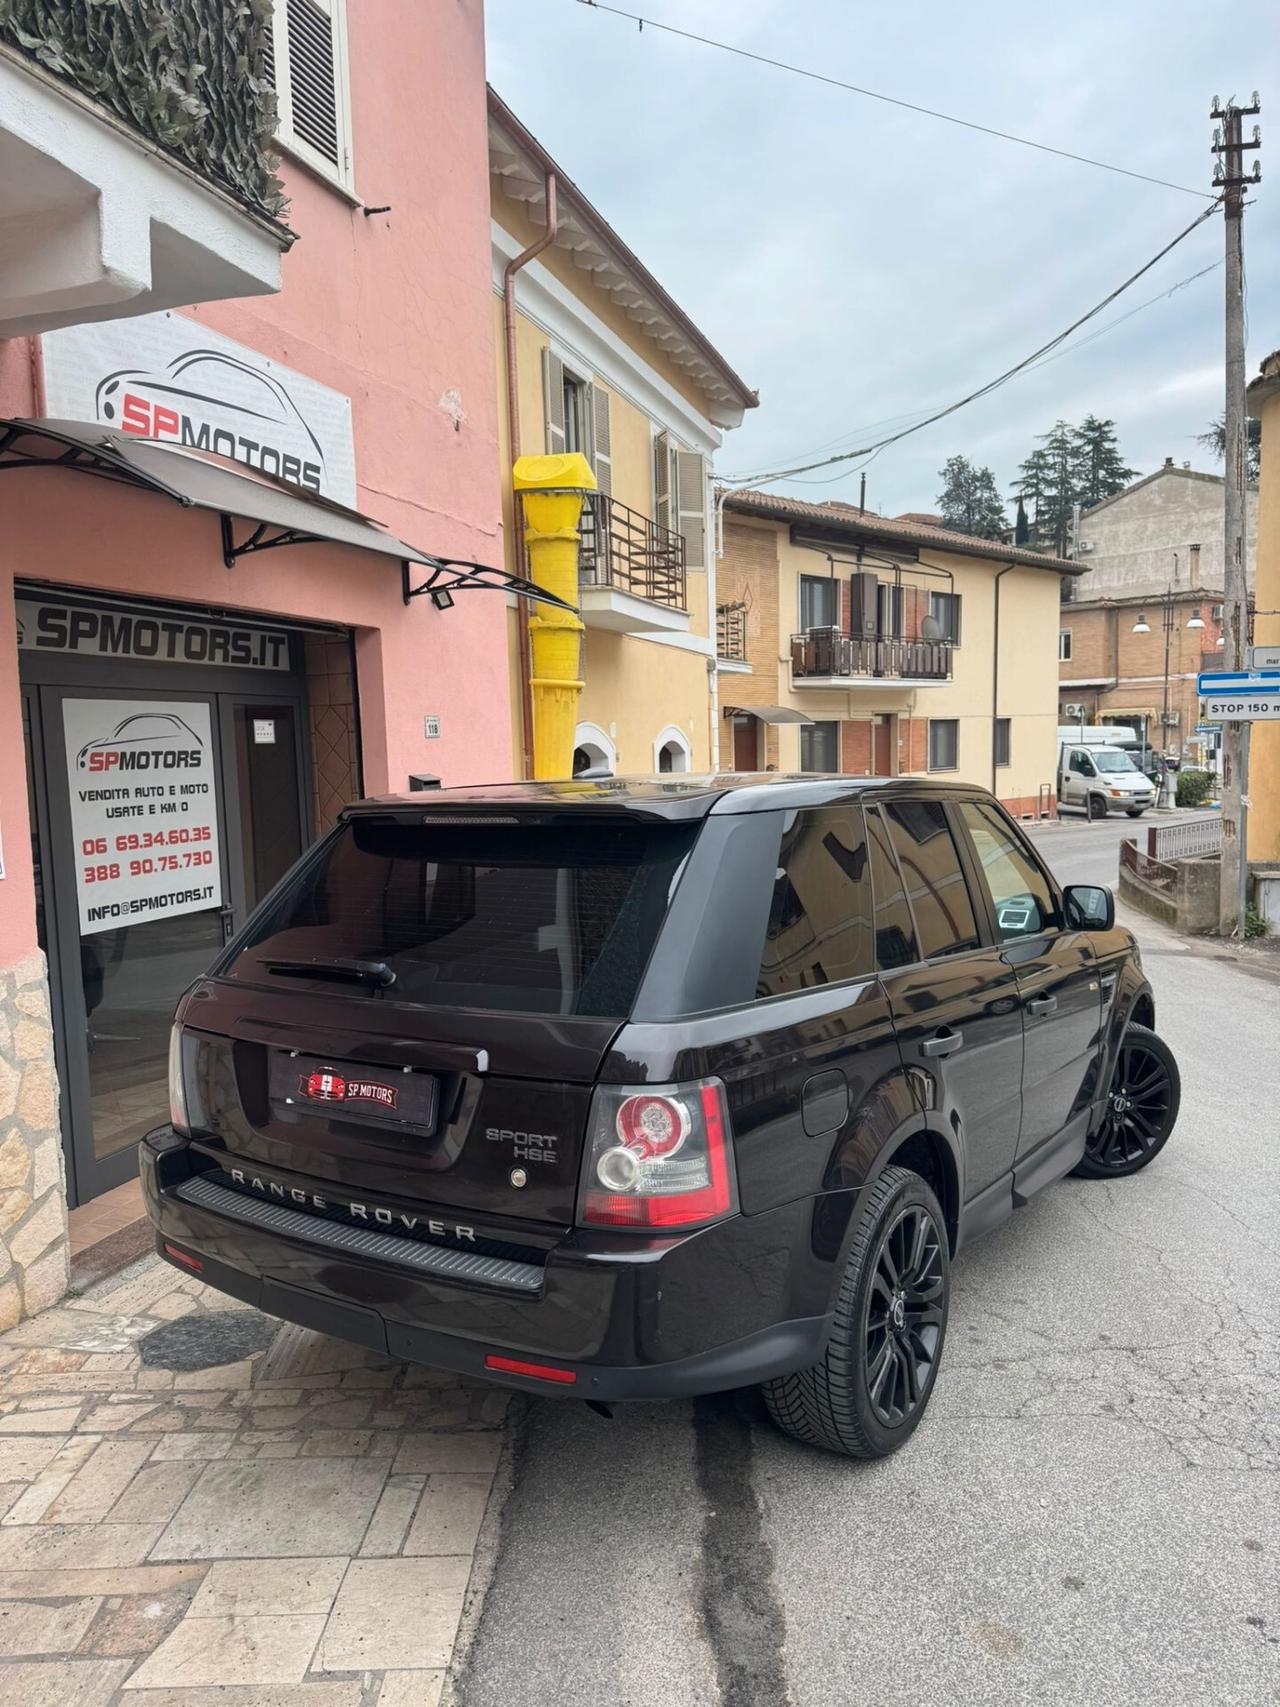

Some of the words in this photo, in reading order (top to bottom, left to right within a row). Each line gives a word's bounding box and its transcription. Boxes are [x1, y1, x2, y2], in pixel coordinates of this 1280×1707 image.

[121, 393, 321, 496] SPMOTORS
[36, 607, 286, 667] SPMOTORS.IT
[1211, 704, 1244, 713] STOP
[1248, 703, 1269, 712] 150
[89, 750, 202, 771] SPMOTORS
[79, 788, 130, 802] VENDITA
[135, 786, 164, 798] AUTO
[169, 785, 176, 796] E
[180, 783, 209, 795] MOTO
[106, 805, 144, 818] USATE
[149, 804, 156, 815] E
[160, 803, 177, 813] KM
[83, 838, 108, 856] 06
[115, 826, 211, 852] 69.34.60.35
[84, 863, 120, 884] 388
[130, 850, 213, 876] 90.75.730
[87, 886, 214, 922] INFO@SPMOTORS.IT
[348, 1083, 359, 1096] SP
[360, 1083, 392, 1103] MOTORS
[485, 1128, 558, 1148] SPORT
[513, 1145, 558, 1163] HSE
[231, 1168, 328, 1209] RANGE
[349, 1202, 477, 1242] ROVER
